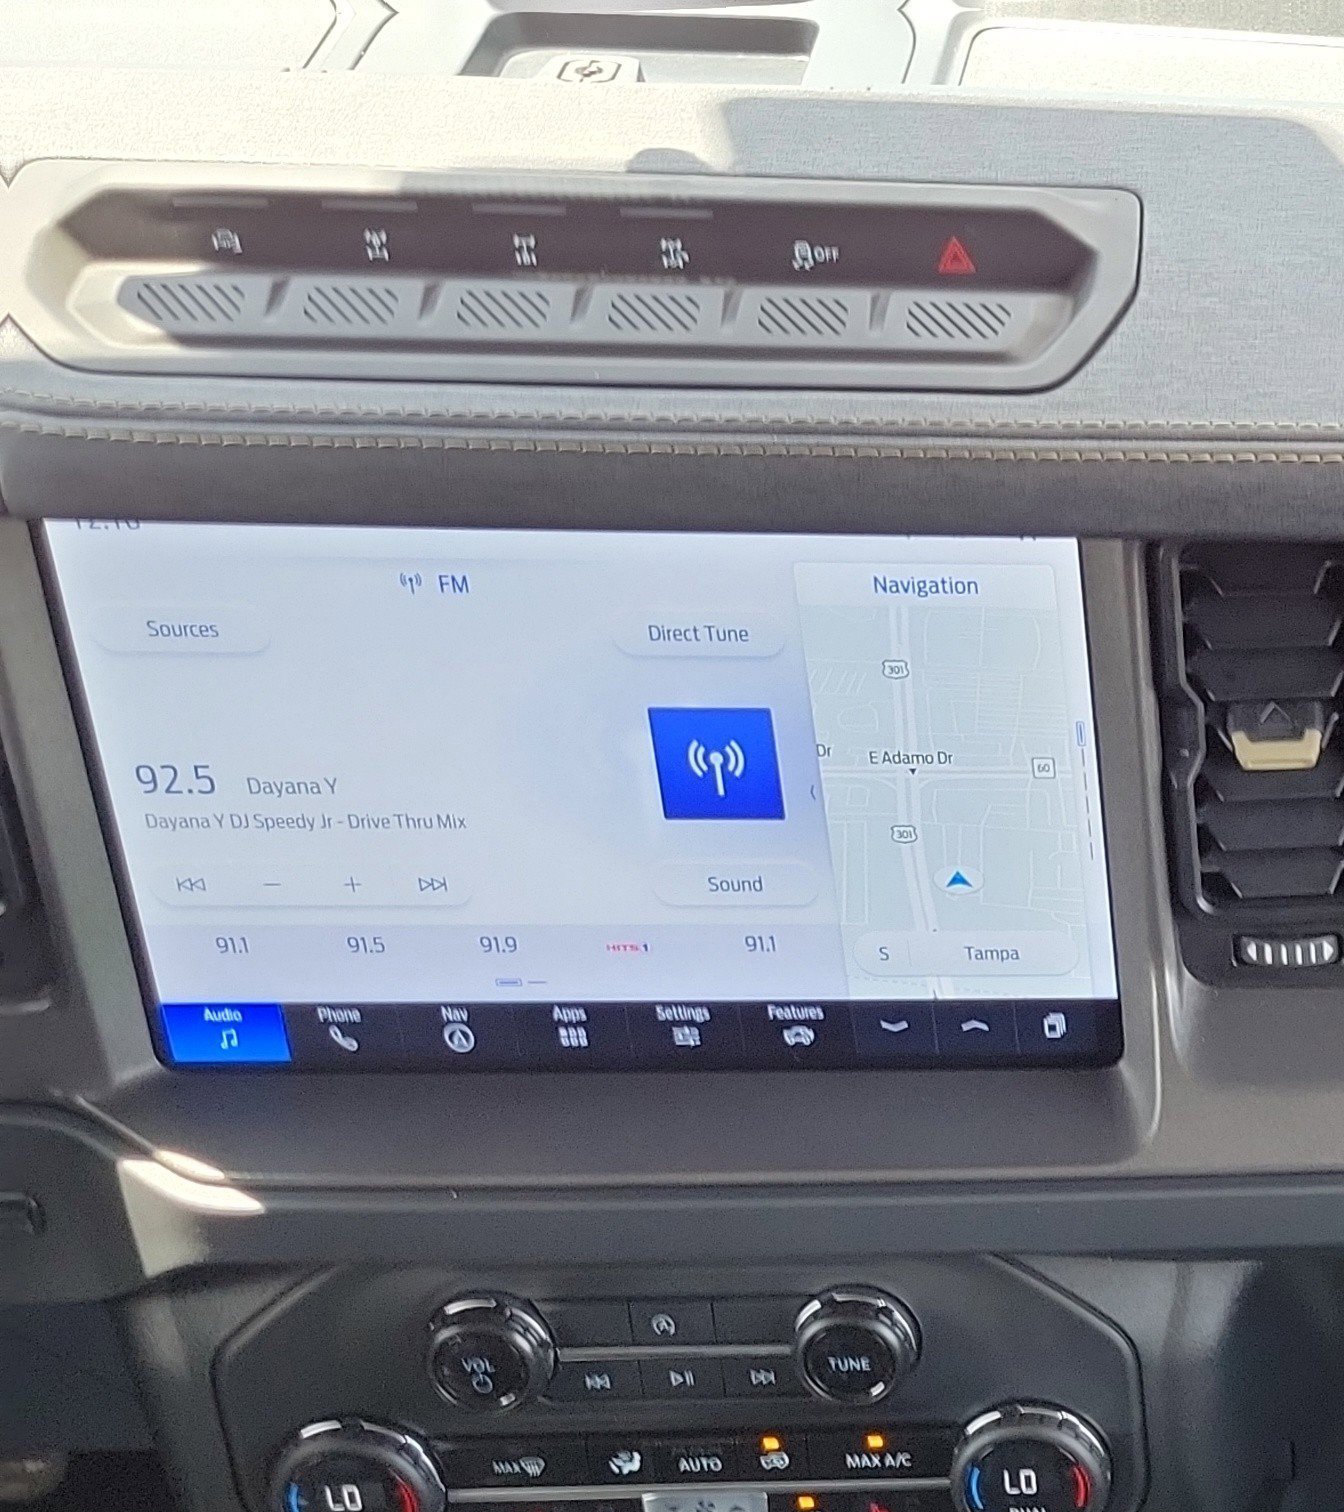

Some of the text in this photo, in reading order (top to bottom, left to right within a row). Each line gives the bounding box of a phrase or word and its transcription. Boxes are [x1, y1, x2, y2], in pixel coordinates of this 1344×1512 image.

[438, 575, 469, 594] FM
[873, 575, 979, 598] Navigation
[147, 620, 219, 638] Sources
[648, 625, 750, 643] Direct Tune
[888, 666, 904, 675] 301
[816, 744, 832, 758] Dr
[869, 751, 954, 765] E Adamo Dr
[135, 764, 217, 795] 92.5
[246, 777, 338, 799] Dayana Y
[145, 813, 211, 832] Dayana
[213, 813, 225, 828] Y
[230, 813, 251, 829] DJ
[253, 813, 316, 832] Speedy
[321, 813, 334, 829] Jr
[348, 813, 391, 830] Drive
[393, 813, 434, 830] Thru
[437, 813, 468, 830] Mix
[897, 830, 913, 839] 301
[708, 876, 764, 893] Sound
[215, 936, 250, 954] 91.1
[346, 936, 386, 954] 91.5
[479, 936, 519, 954] 91.9
[744, 935, 777, 953] 91.1
[878, 946, 890, 962] S
[963, 946, 1020, 965] Tampa
[204, 1006, 243, 1023] Audio
[316, 1006, 362, 1024] Phone
[441, 1005, 469, 1022] Nav
[553, 1005, 588, 1024] Apps
[655, 1003, 711, 1023] Settings
[766, 1003, 825, 1021] Features
[461, 1356, 496, 1374] VOL
[827, 1355, 871, 1372] TUNE
[492, 1459, 522, 1475] MAX
[678, 1456, 723, 1473] AUTO
[845, 1452, 912, 1469] MAX A/C
[1003, 1468, 1037, 1495] LO
[324, 1483, 363, 1512] LO
